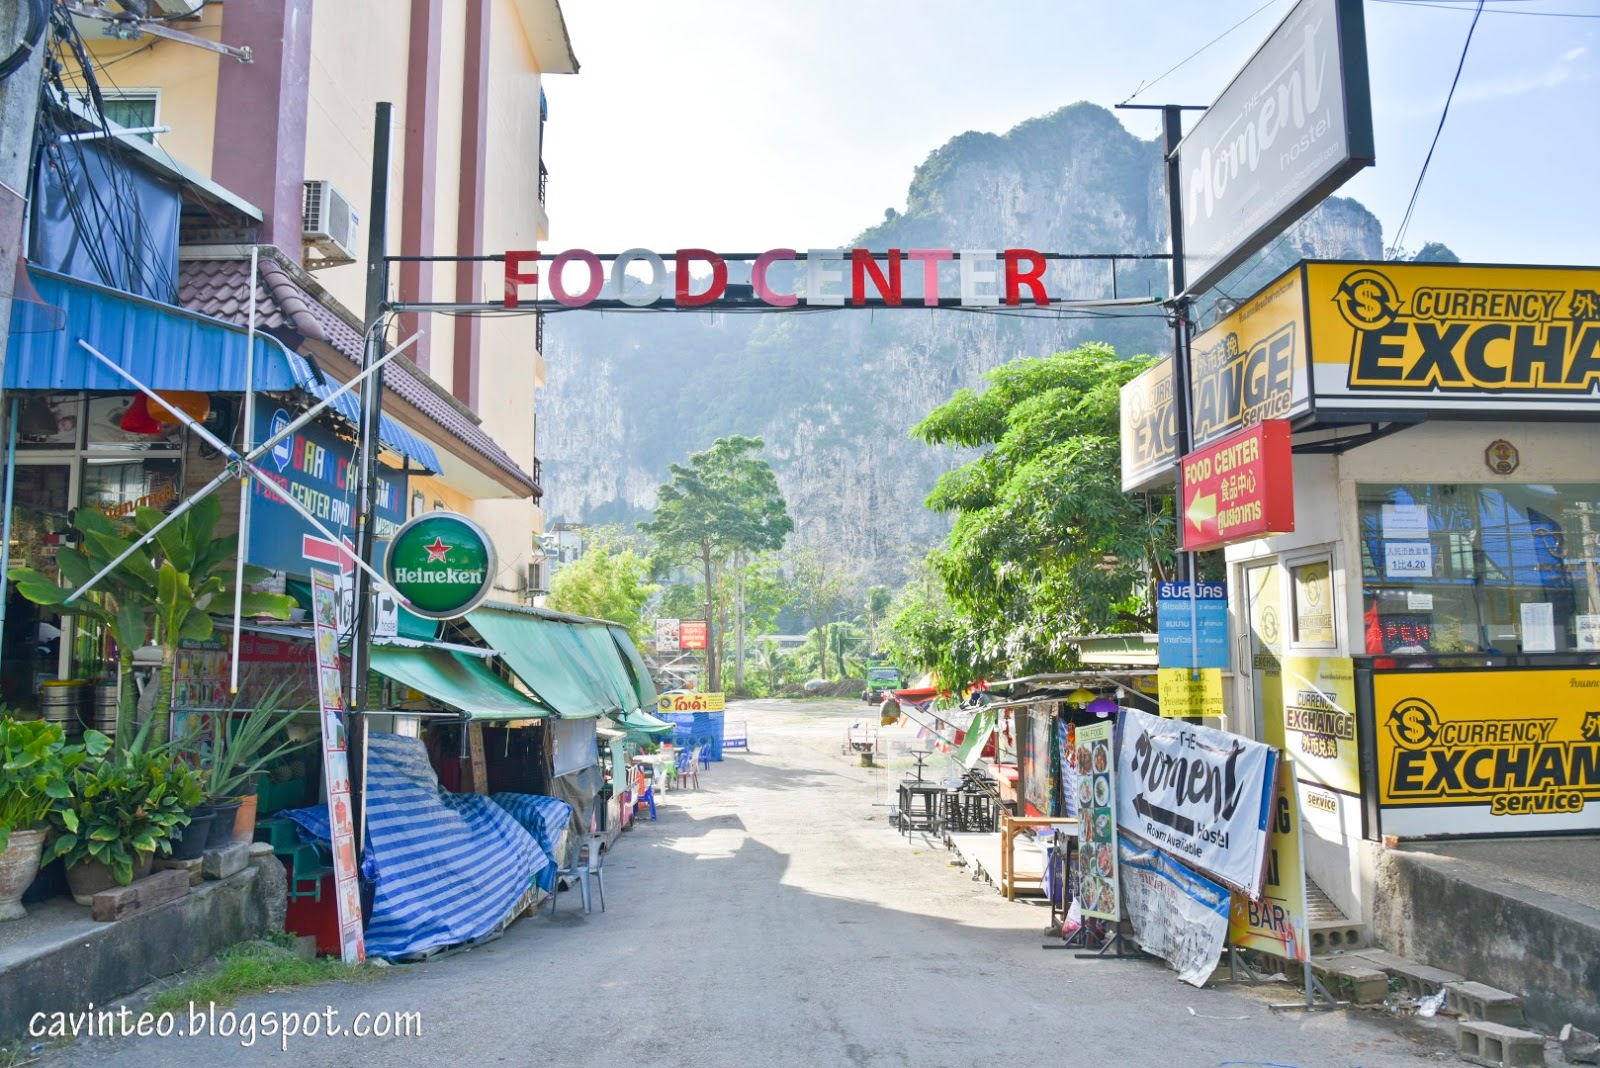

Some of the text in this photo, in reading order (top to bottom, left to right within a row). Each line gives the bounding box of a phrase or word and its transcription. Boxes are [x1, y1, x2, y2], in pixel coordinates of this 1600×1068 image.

[1243, 91, 1261, 116] THE
[1189, 16, 1326, 228] Moment
[1280, 111, 1331, 171] hostel
[504, 248, 1050, 308] FOOD CENTER
[1416, 291, 1558, 318] CURRENCY
[1243, 391, 1290, 426] service
[1185, 436, 1259, 487] FOOD CENTER
[1221, 469, 1257, 503] 食品中心
[331, 498, 350, 527] AND
[395, 567, 483, 585] Heineken
[1371, 627, 1428, 641] OPEN
[1090, 727, 1103, 737] FOOD
[1287, 710, 1353, 738] EXCHANGE
[1444, 721, 1552, 745] CURRENCY
[1179, 732, 1196, 750] THE
[1131, 730, 1246, 824] Moment
[1307, 794, 1336, 811] service
[1494, 782, 1580, 812] service
[1147, 823, 1203, 858] Room Available
[1198, 823, 1229, 849] Hostel
[1249, 898, 1287, 933] BAR
